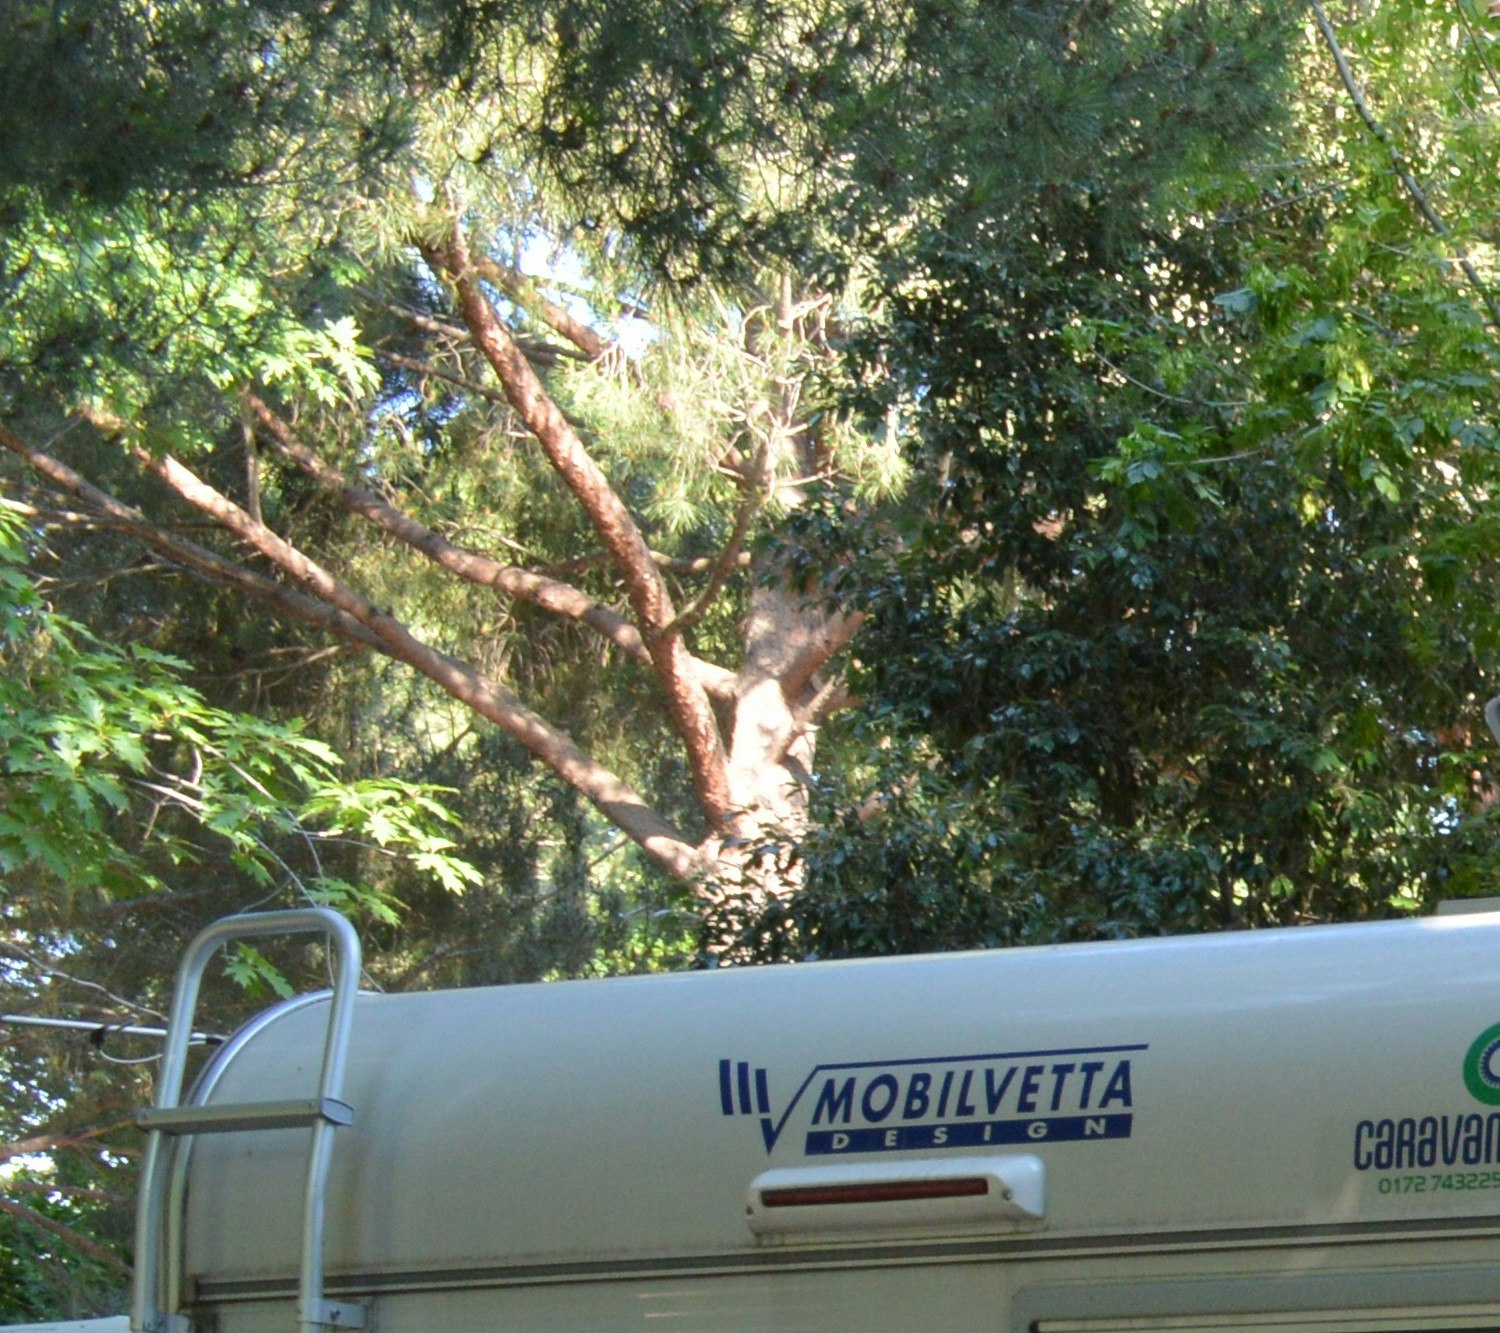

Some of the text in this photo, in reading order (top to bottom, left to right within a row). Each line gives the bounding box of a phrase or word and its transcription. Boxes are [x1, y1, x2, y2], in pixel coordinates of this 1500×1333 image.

[811, 1060, 1133, 1126] MOBILVETTA
[831, 1119, 1106, 1150] DESIGN
[1378, 1176, 1427, 1195] 0172
